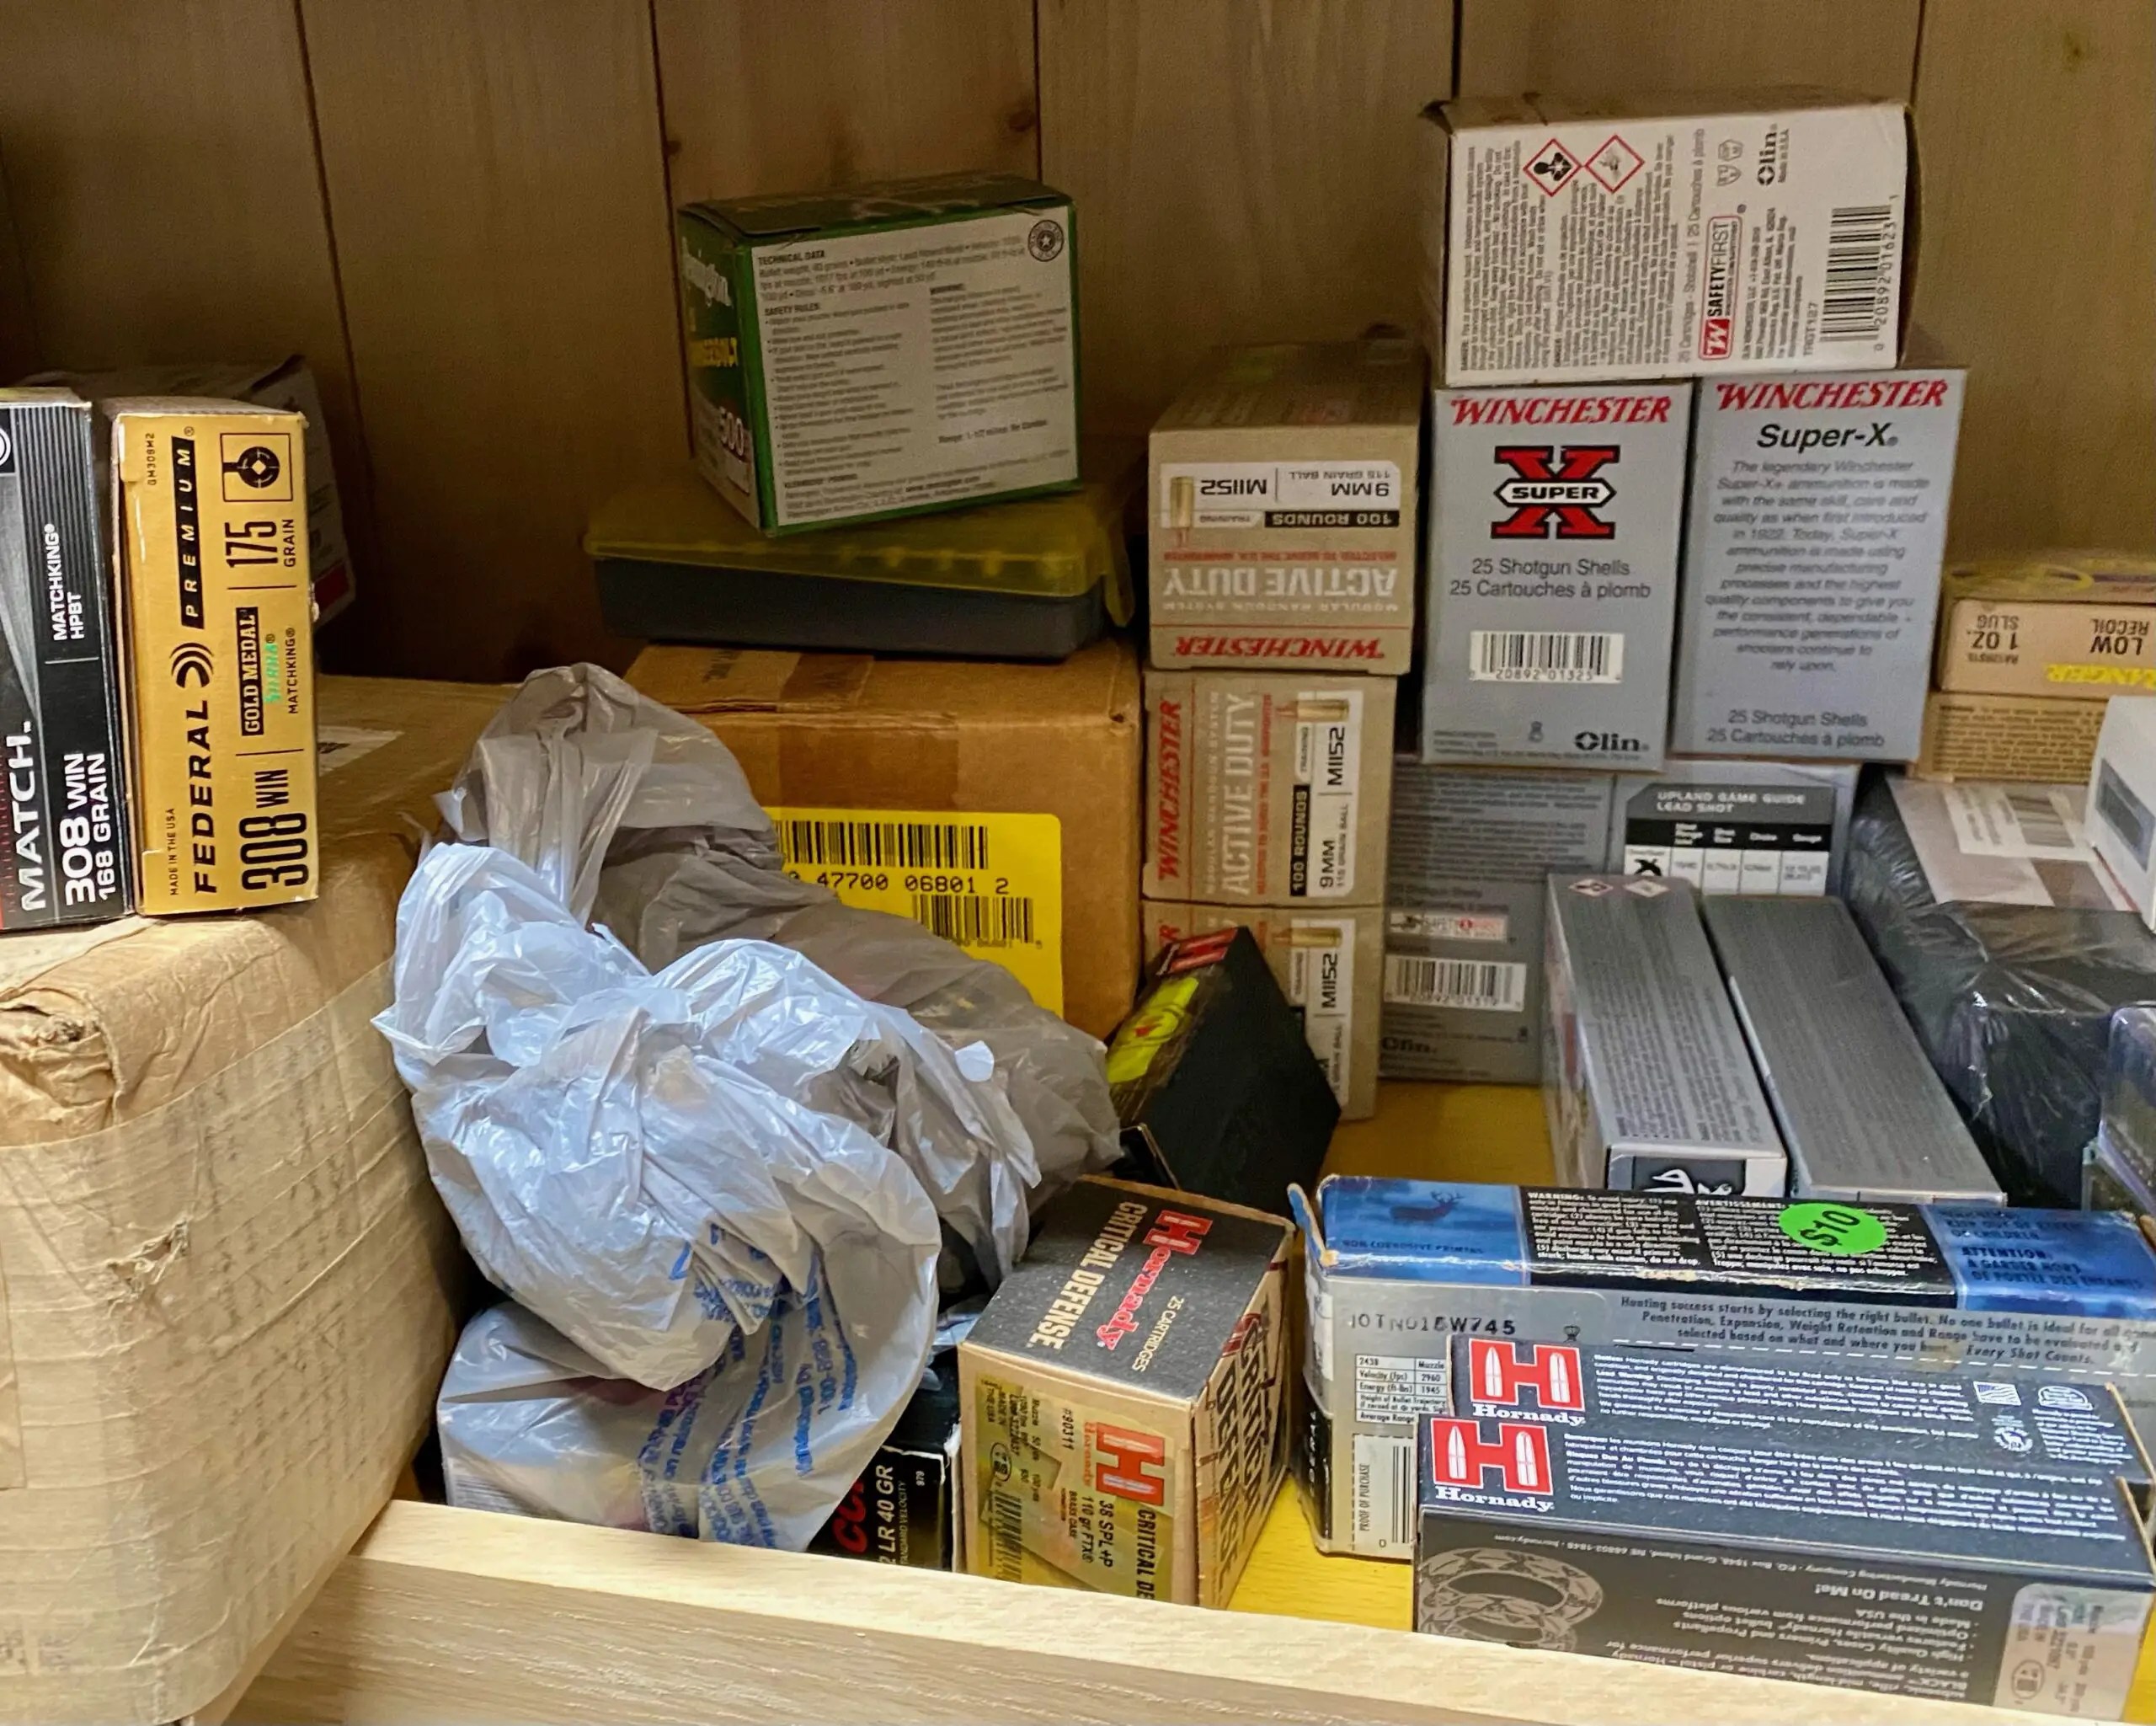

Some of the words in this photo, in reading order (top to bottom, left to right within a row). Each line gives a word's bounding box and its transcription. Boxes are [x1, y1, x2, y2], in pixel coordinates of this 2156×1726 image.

[1757, 131, 1777, 186] Olin
[1687, 222, 1700, 237] 25
[1881, 222, 1897, 271] 01623
[1873, 275, 1892, 325] 20892
[1716, 379, 1948, 411] WINCHESTER
[1450, 395, 1672, 425] WINCHESTER
[1289, 470, 1319, 481] BALL
[1324, 470, 1363, 480] GRAIN
[1511, 486, 1599, 500] SUPER
[1273, 512, 1350, 526] ROUNDS
[1357, 512, 1392, 526] 100
[223, 521, 279, 569] 175
[281, 518, 296, 568] GRAIN
[1472, 558, 1493, 574] 25
[1499, 558, 1572, 580] Shotgun
[1576, 558, 1630, 576] Shells
[1163, 567, 1256, 597] DUTY
[1265, 567, 1398, 597] ACTIVE
[1449, 580, 1471, 596] 25
[1476, 580, 1575, 598] Cartouches
[1580, 580, 1591, 597] à
[1597, 581, 1651, 600] plomb
[69, 591, 85, 639] HPBT
[1319, 602, 1399, 612] MODULAR
[1977, 614, 2019, 630] SLUG
[2092, 618, 2150, 636] RECOIL
[239, 614, 259, 681] MEDAL
[1175, 636, 1386, 659] WINCHESTER
[1967, 630, 1999, 649] OZ.
[2009, 633, 2019, 649] 1
[2089, 635, 2143, 655] LOW
[243, 684, 261, 733] GOLD
[1728, 709, 1748, 724] 25
[1752, 710, 1816, 729] Shotgun
[1820, 712, 1868, 727] Shells
[1225, 692, 1255, 777] DUTY
[1574, 731, 1641, 752] Olin
[1707, 728, 1726, 742] 25
[1731, 728, 1819, 745] Cartouches
[1836, 731, 1885, 748] plomb
[64, 752, 85, 809] WIN
[256, 768, 290, 809] WIN
[1158, 700, 1182, 881] WINCHESTER
[87, 752, 112, 843] GRAIN
[189, 698, 217, 894] FEDERAL
[1657, 792, 1713, 802] UPLAND
[1717, 792, 1757, 803] GAME
[1762, 794, 1806, 804] GUIDE
[1657, 803, 1693, 812] LEAD
[1696, 803, 1735, 813] SHOT
[165, 809, 176, 829] USA
[1294, 790, 1308, 857] ROUNDS
[167, 832, 177, 852] THE
[238, 812, 308, 891] 308
[1222, 785, 1253, 895] ACTIVE
[60, 817, 94, 906] 308
[168, 854, 178, 864] IN
[93, 853, 115, 900] 168
[168, 868, 179, 895] MADE
[817, 873, 889, 890] 47700
[905, 875, 976, 894] 06801
[995, 878, 1009, 895] 2
[1293, 863, 1305, 890] 100
[1528, 1192, 1584, 1201] WARNING:
[1081, 1201, 1148, 1269] CRITICAL
[1799, 1209, 1860, 1247] $10
[1097, 1210, 1214, 1351] Hornady
[1029, 1269, 1106, 1350] DEFENSE
[1166, 1295, 1185, 1312] 25
[1620, 1296, 1667, 1312] Hunting
[1670, 1301, 1714, 1312] success
[1718, 1302, 1754, 1314] starts
[1758, 1304, 1773, 1317] by
[1778, 1306, 1831, 1321] selecting
[1836, 1308, 1856, 1319] the
[1859, 1309, 1890, 1325] right
[1893, 1312, 1933, 1325] bullet.
[1939, 1314, 1956, 1327] No
[1961, 1317, 1983, 1328] one
[1988, 1317, 2024, 1331] bullet
[2027, 1319, 2039, 1332] is
[2043, 1321, 2074, 1333] ideal
[2079, 1323, 2098, 1335] for
[1131, 1310, 1177, 1372] CARTRIDGES
[1677, 1328, 1726, 1340] selected
[1730, 1329, 1765, 1343] based
[1769, 1333, 1784, 1344] on
[1788, 1333, 1819, 1344] what
[1823, 1336, 1845, 1347] and
[1849, 1337, 1888, 1350] where
[1892, 1341, 1917, 1354] you
[1966, 1344, 2004, 1360] Every
[2010, 1347, 2041, 1360] Shot
[2045, 1349, 2094, 1365] Counts.
[1359, 1370, 1385, 1381] Velocity
[1388, 1371, 1408, 1382] (fps)
[1421, 1373, 1441, 1382] 2960
[1359, 1381, 1385, 1393] Energy
[1421, 1386, 1440, 1395] 1945
[1471, 1403, 1587, 1427] Hornady
[876, 1465, 894, 1497] GR
[1359, 1463, 1370, 1494] PURCHASE
[876, 1500, 894, 1518] 40
[897, 1480, 908, 1521] VELOCITY
[1082, 1496, 1094, 1514] 110
[1359, 1494, 1370, 1506] OF
[1434, 1484, 1555, 1513] Hornady
[1079, 1516, 1091, 1531] gr
[1358, 1507, 1370, 1532] PROOF
[878, 1523, 897, 1552] LR
[1097, 1520, 1113, 1547] SPL
[1137, 1509, 1156, 1581] CRITICAL
[1097, 1548, 1113, 1568] +P
[1815, 1583, 1849, 1597] Me!
[1852, 1588, 1876, 1600] On
[1879, 1590, 1931, 1606] Tread
[1855, 1608, 1886, 1621] USA
[1935, 1595, 1983, 1611] Don't
[1888, 1611, 1911, 1622] the
[1915, 1615, 1928, 1624] in
[1931, 1616, 1971, 1629] Made
